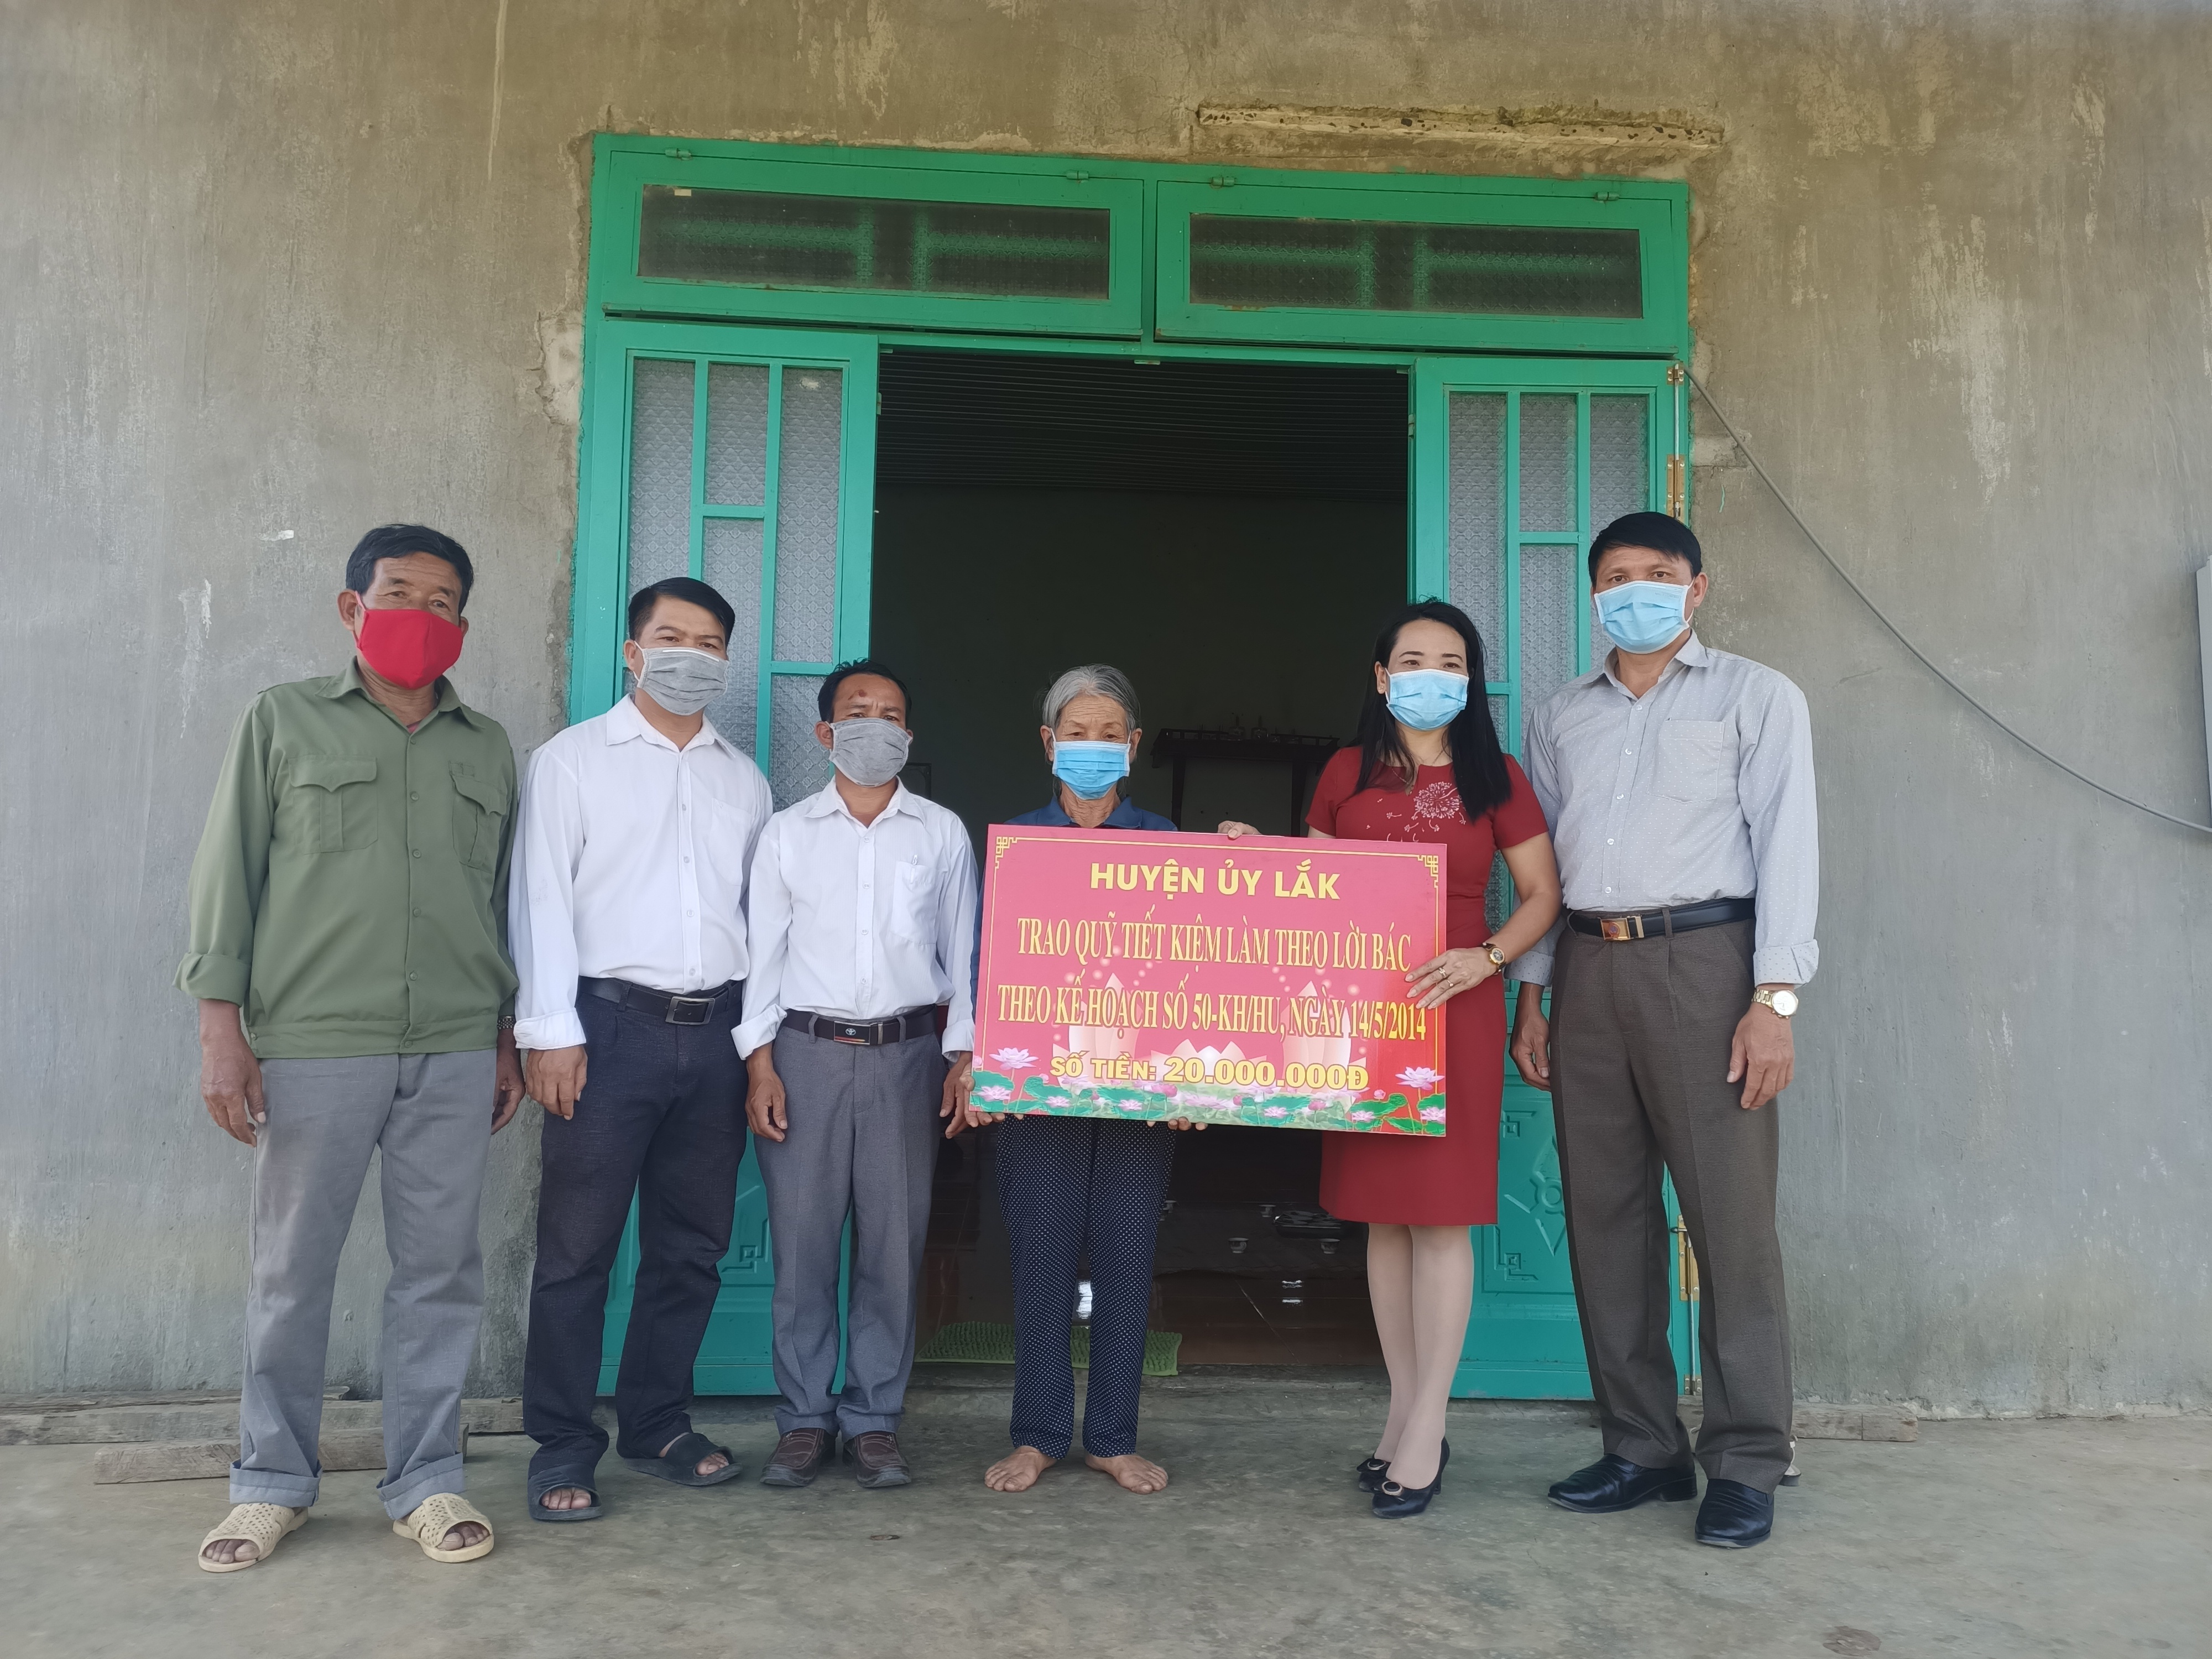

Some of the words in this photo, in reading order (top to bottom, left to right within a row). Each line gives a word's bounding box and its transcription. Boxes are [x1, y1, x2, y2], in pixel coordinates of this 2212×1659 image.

[1091, 858, 1204, 900] HUYỆN
[1218, 859, 1263, 896] ỦY
[1275, 858, 1340, 899] LẮK
[1017, 918, 1070, 956] TRAO
[1075, 911, 1117, 966] QUỸ
[1121, 904, 1166, 960] TIẾT
[1170, 913, 1222, 972] KIỆM
[1225, 915, 1270, 964] LÀM
[1274, 929, 1328, 968] THEO
[1332, 920, 1368, 969] LỜI
[1371, 922, 1411, 972] BÁC
[998, 984, 1051, 1024] THEO
[1055, 968, 1085, 1025] KẾ
[1087, 987, 1159, 1039] HOẠCH
[1162, 973, 1189, 1030] SỐ
[1192, 993, 1286, 1042] 50-KH/HU,
[1288, 986, 1345, 1037] NGÀY
[1350, 999, 1426, 1041] 14/5/2014
[1050, 1050, 1088, 1078] SỐ
[1091, 1051, 1157, 1081] TIỀN:
[1163, 1057, 1369, 1091] 20.000.000Đ
